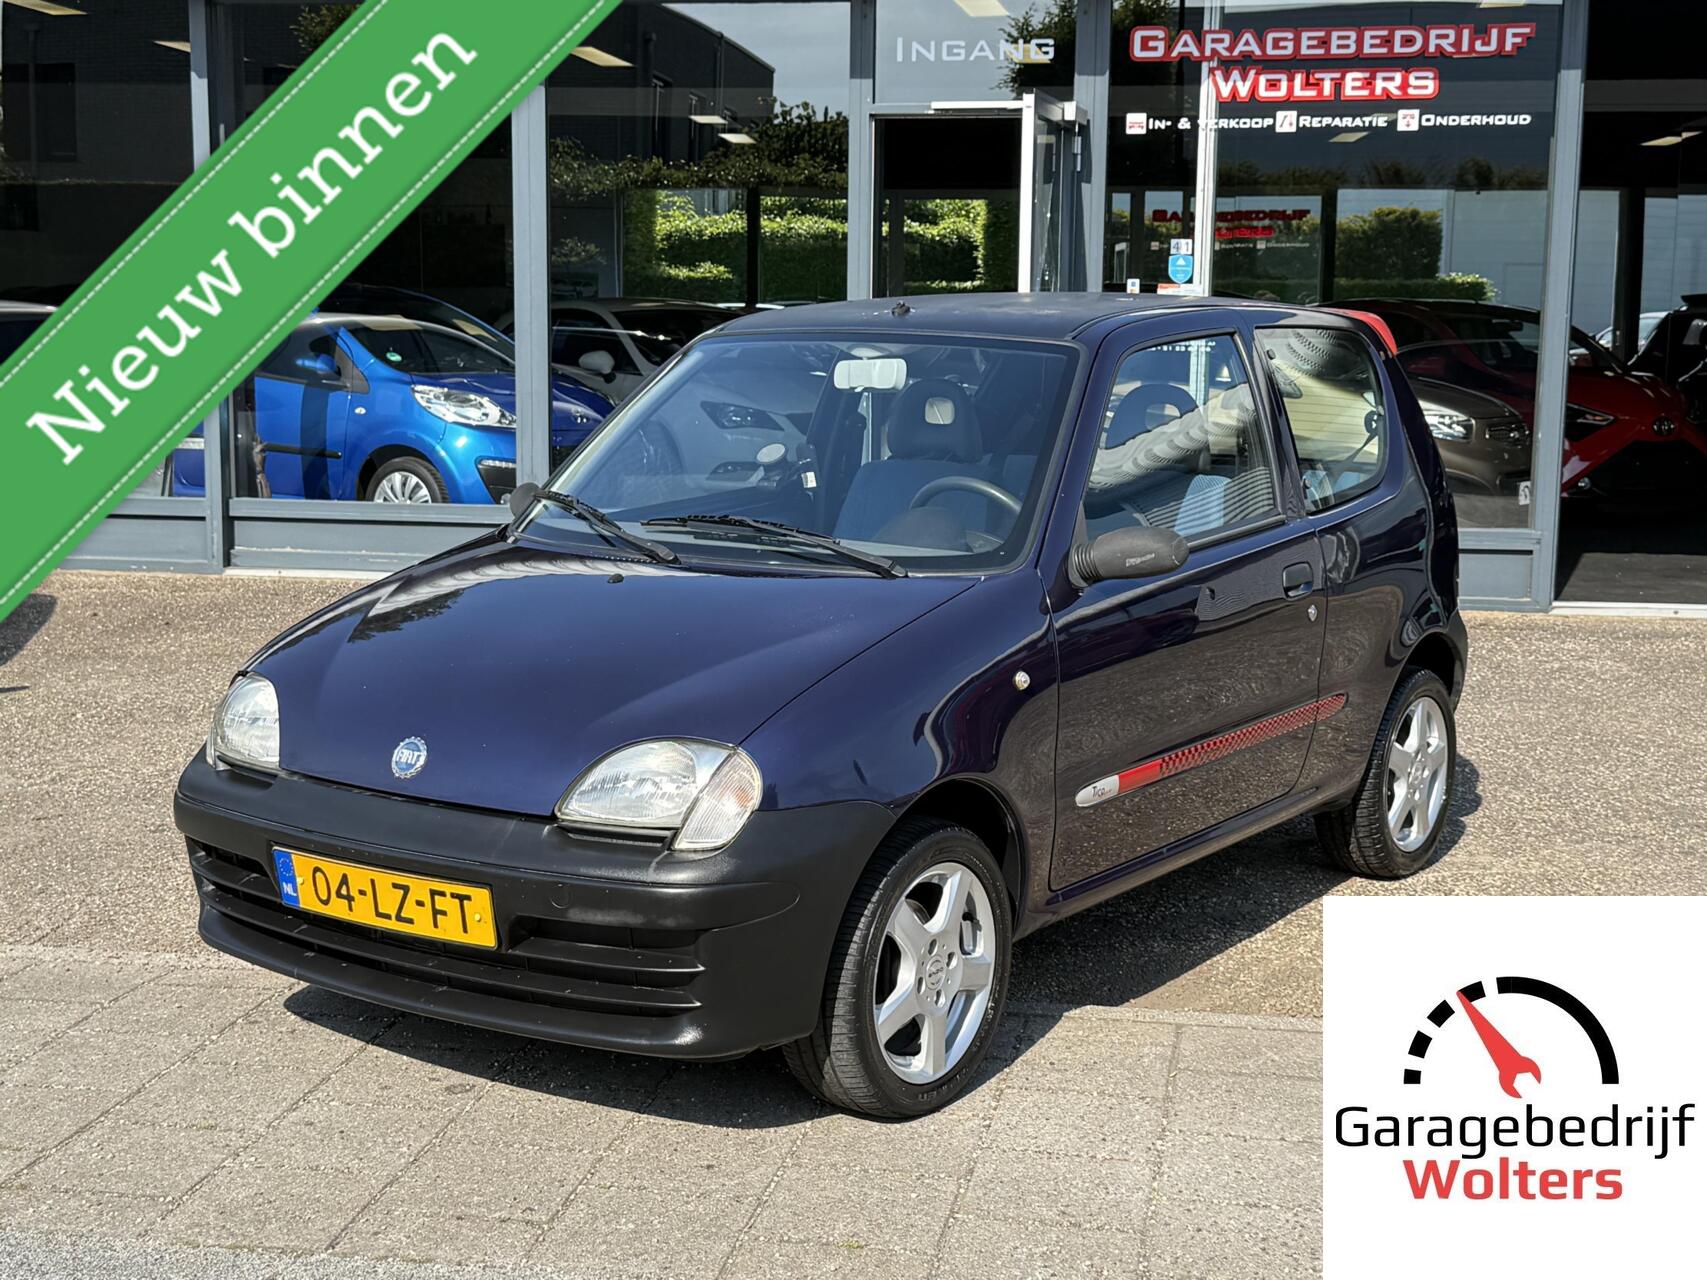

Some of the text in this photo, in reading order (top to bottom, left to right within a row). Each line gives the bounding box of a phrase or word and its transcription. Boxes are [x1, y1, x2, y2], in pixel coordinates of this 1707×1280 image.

[896, 37, 1055, 62] INGANG
[1131, 24, 1535, 61] GARAGEBEDRIJF
[1212, 67, 1438, 101] WOLTERS
[1177, 117, 1191, 130] &
[1299, 115, 1388, 128] REPARATIE
[1421, 113, 1532, 127] ONDERHOUD
[283, 881, 298, 897] NL
[311, 865, 472, 934] 04-LZ-FT
